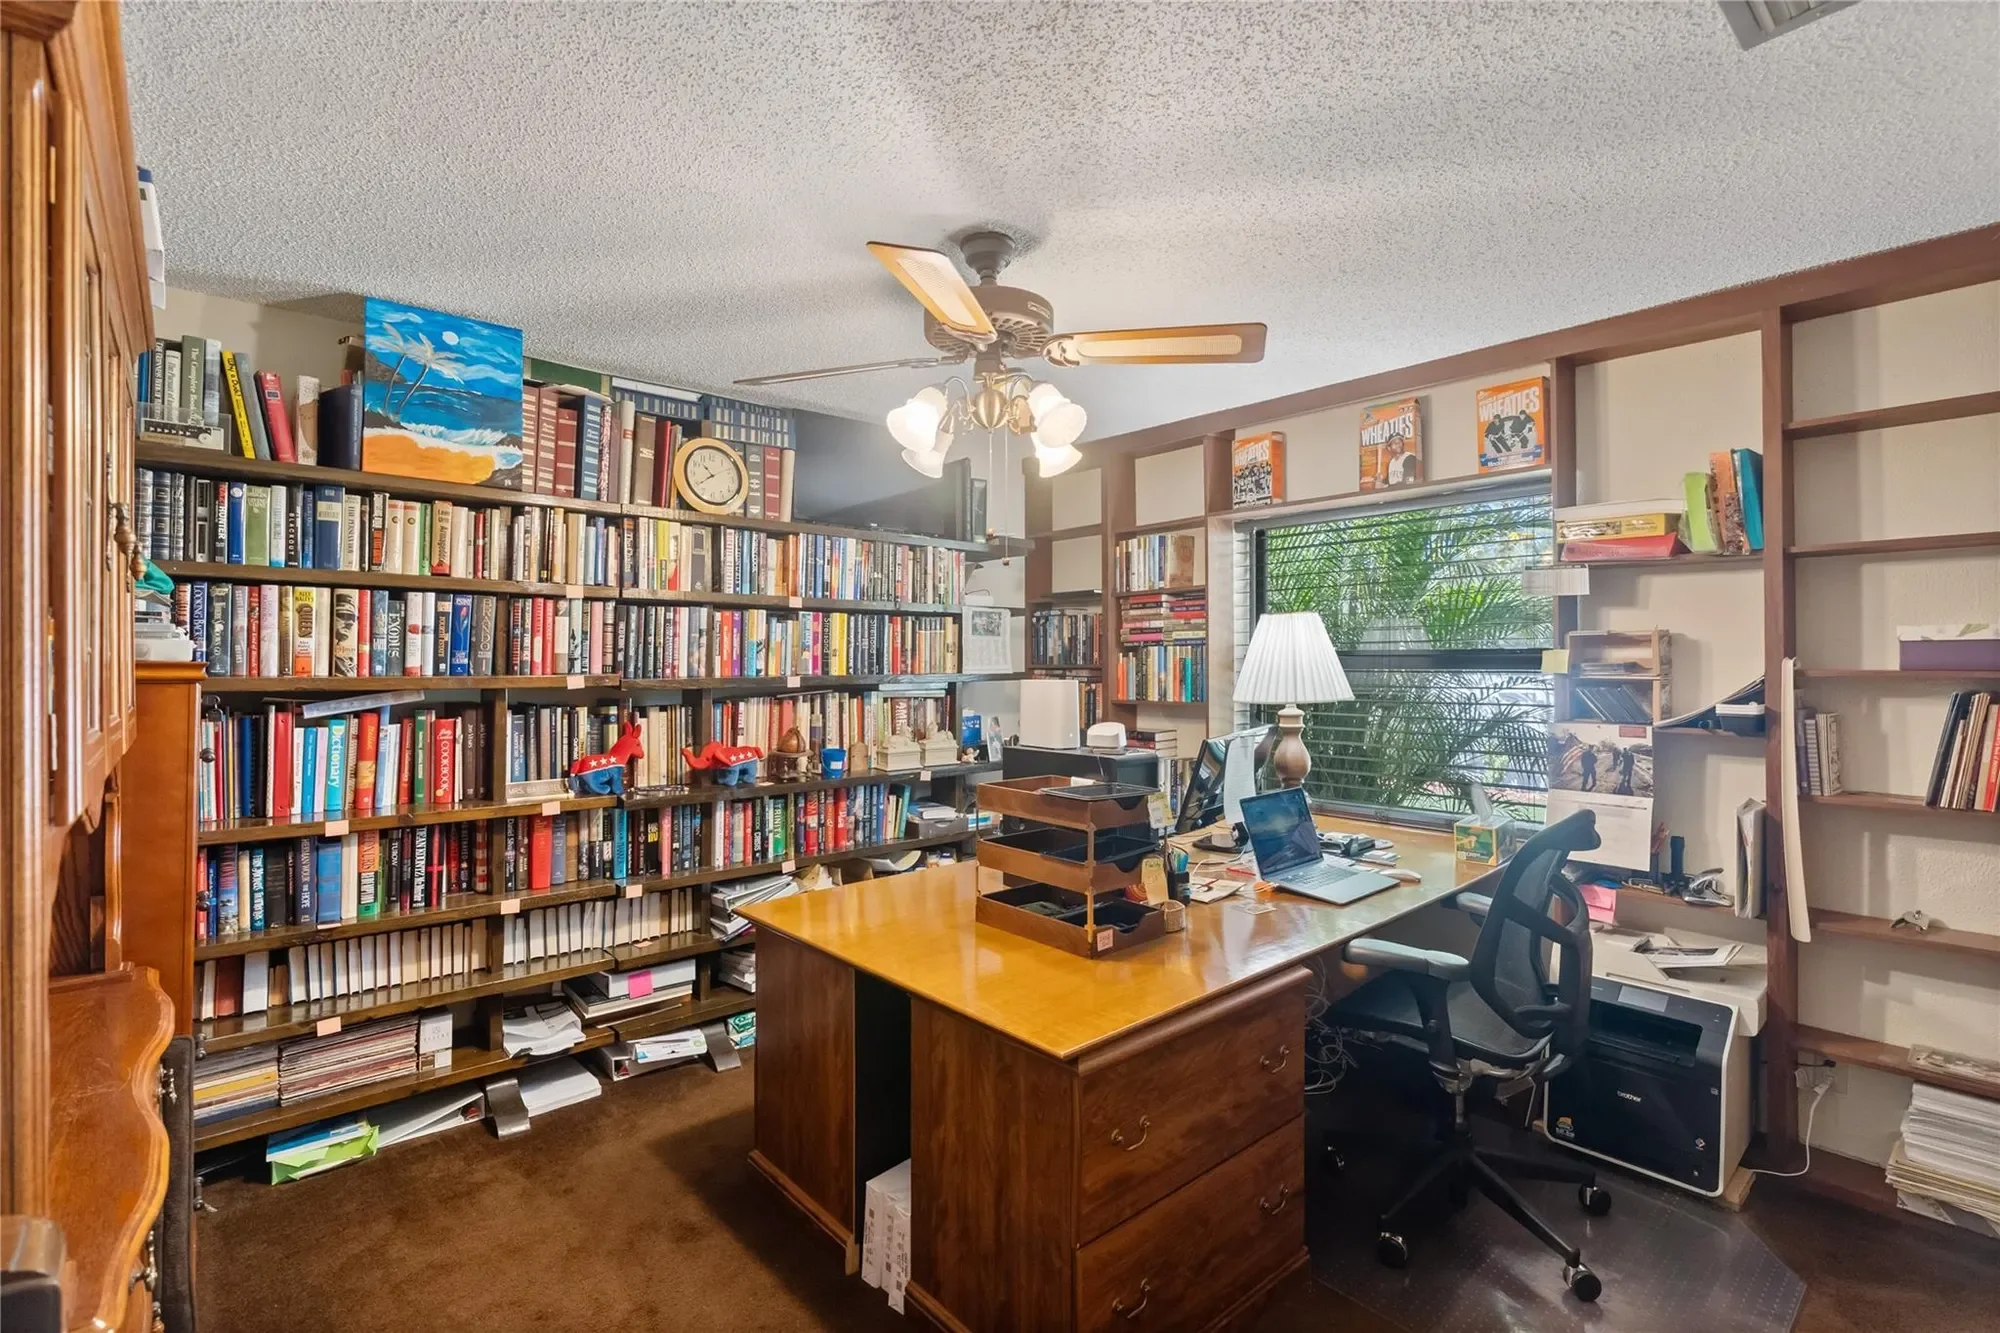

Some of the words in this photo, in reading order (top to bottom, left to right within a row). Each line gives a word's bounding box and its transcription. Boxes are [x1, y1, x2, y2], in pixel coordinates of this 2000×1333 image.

[155, 353, 164, 377] GUINNESS
[191, 347, 199, 360] The
[188, 361, 198, 392] Complete
[190, 394, 198, 411] Book
[1479, 386, 1540, 422] WHEATIES
[1361, 413, 1415, 446] WHEATIES
[217, 505, 226, 540] HUNTER
[193, 585, 204, 618] LOOKING
[193, 619, 204, 637] BACK
[300, 605, 313, 638] QUEEN
[388, 613, 401, 658] EXODUS
[480, 598, 493, 651] BRANDO
[328, 725, 345, 788] Dictionary
[440, 740, 450, 792] COOKBOOK
[773, 804, 782, 839] TRINITY
[301, 839, 310, 865] HERMAN
[416, 827, 427, 849] DEAN
[753, 831, 762, 851] CRISIS
[301, 865, 310, 882] WOUK
[414, 849, 426, 877] KOONTZ
[301, 892, 310, 908] HOPE
[1616, 1090, 1642, 1102] brother
